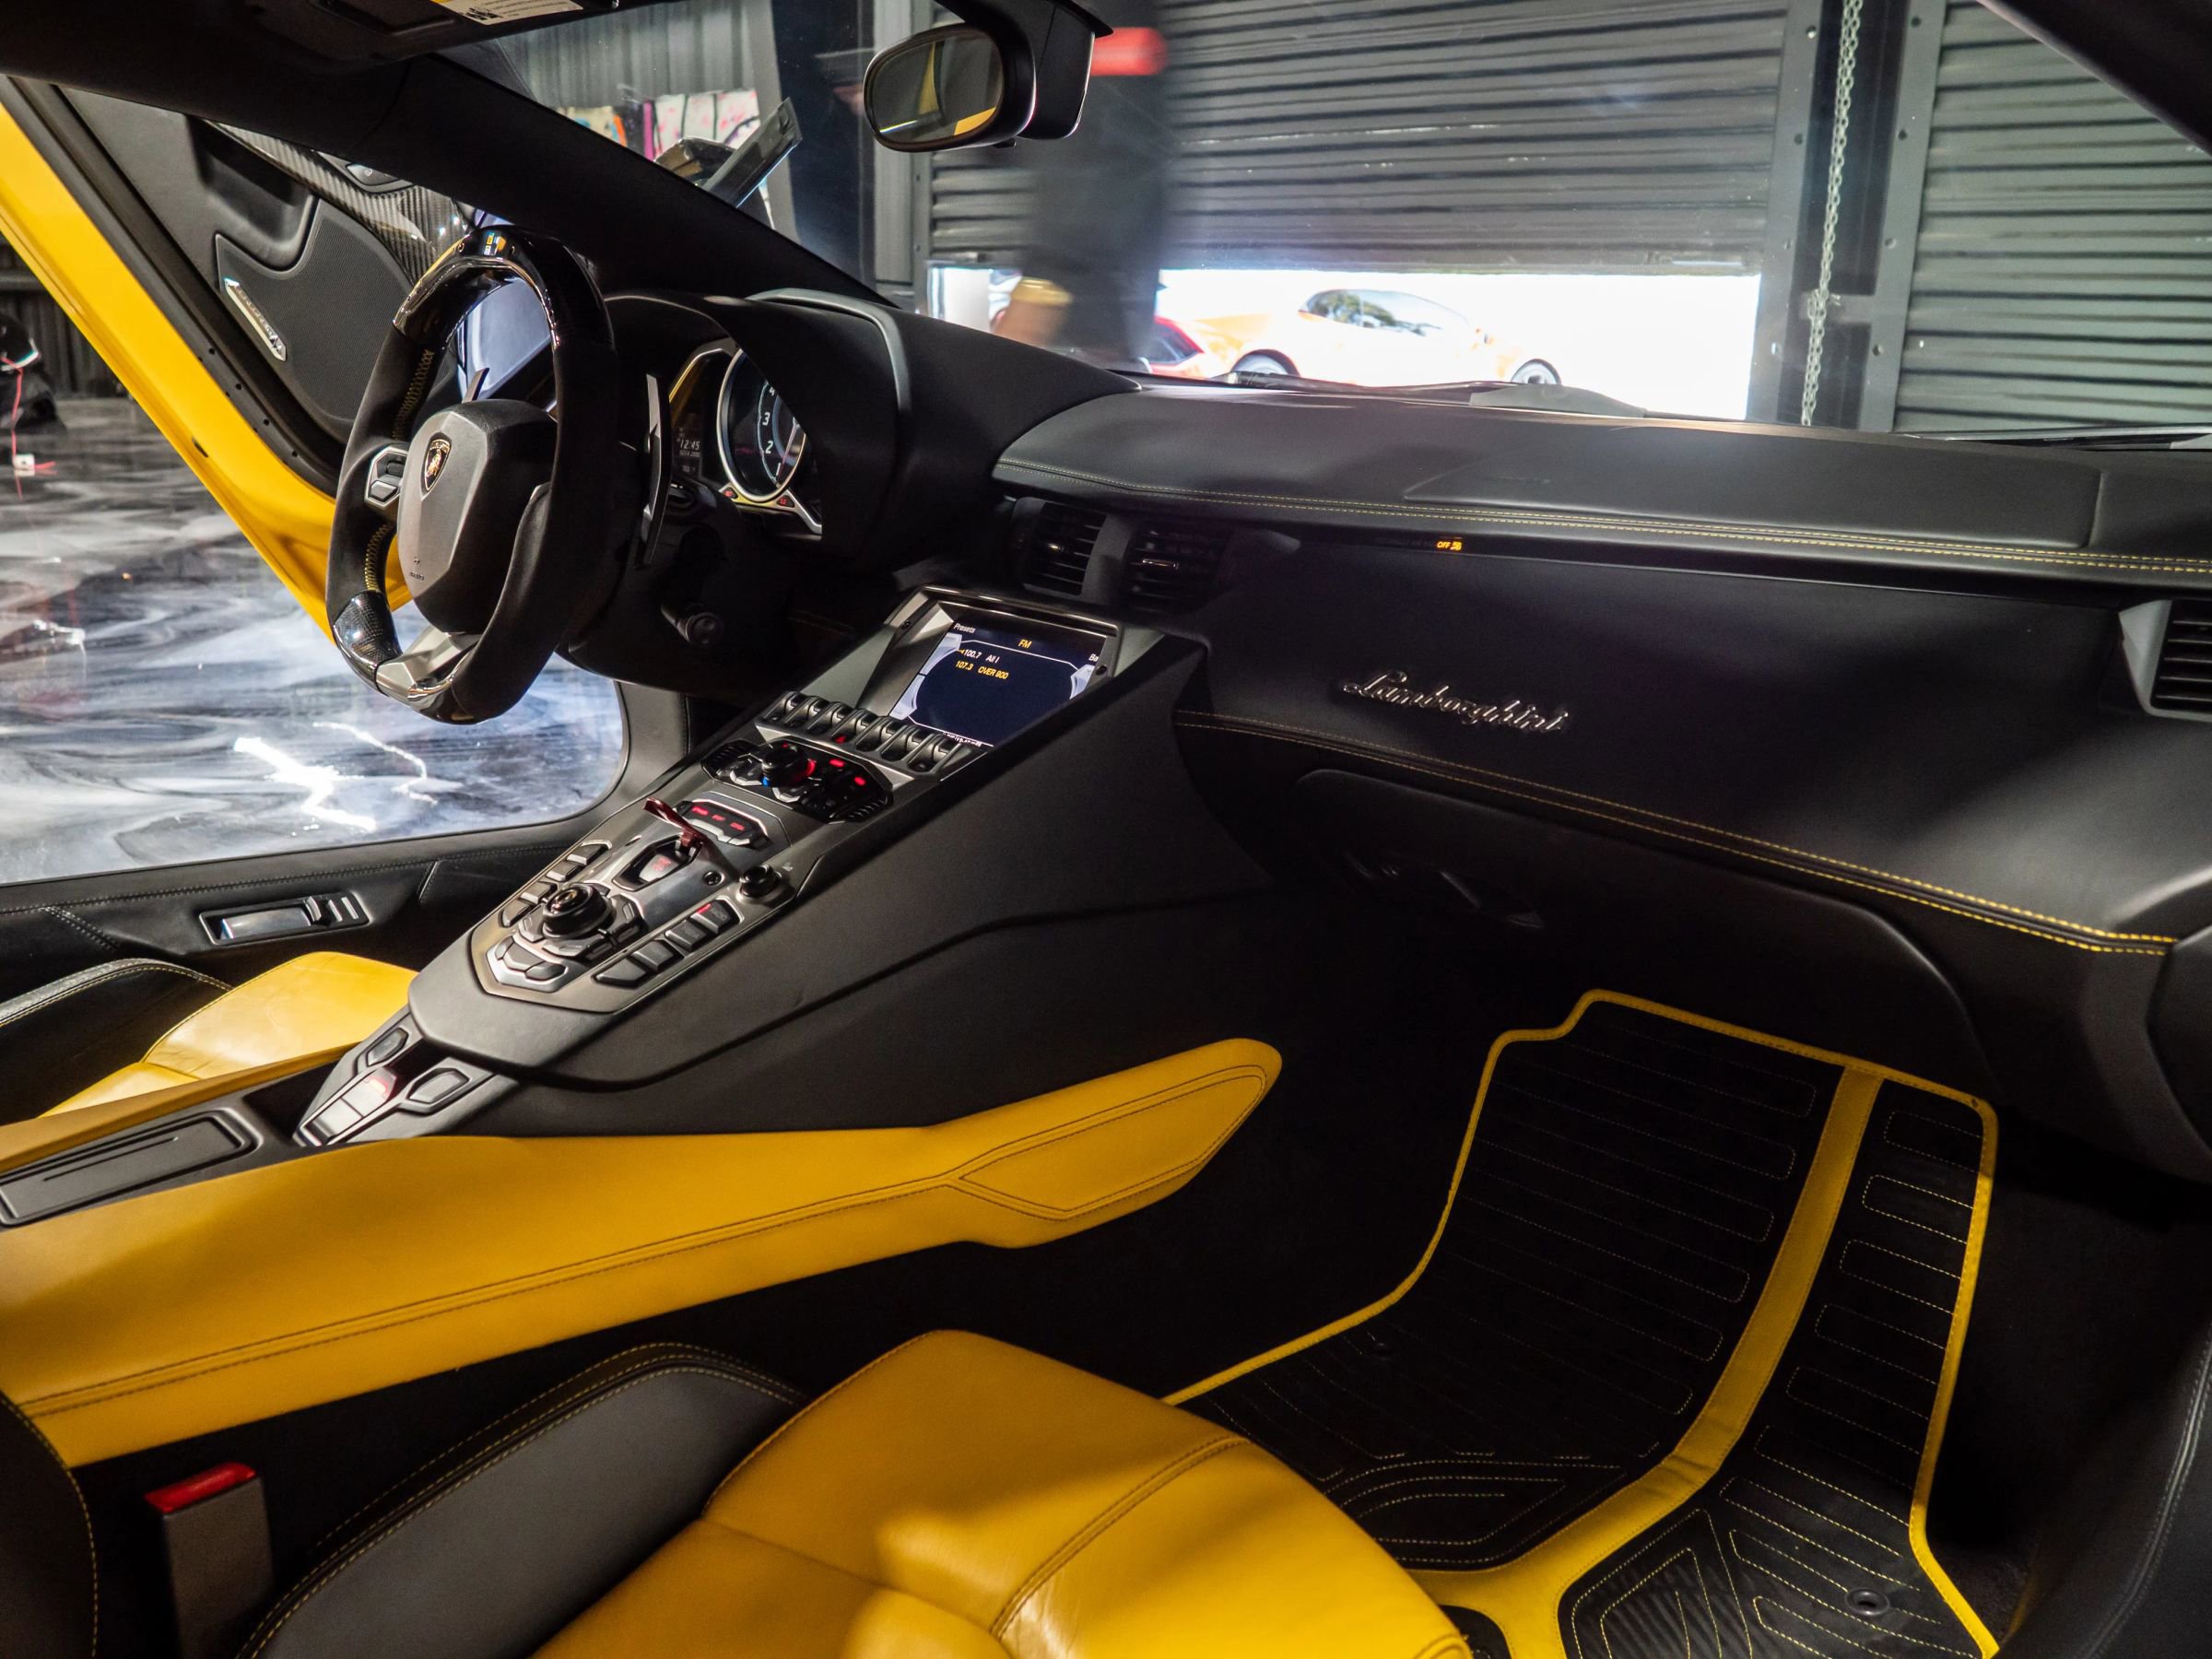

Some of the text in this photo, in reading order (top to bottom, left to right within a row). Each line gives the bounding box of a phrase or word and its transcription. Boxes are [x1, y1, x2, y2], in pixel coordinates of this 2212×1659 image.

[762, 411, 771, 426] 3
[679, 438, 700, 451] 12:45
[765, 441, 773, 454] 2
[775, 463, 782, 476] 1
[954, 622, 975, 633] Presets
[1018, 639, 1032, 648] FM
[963, 649, 982, 659] 100.7
[956, 660, 973, 670] 107.3
[978, 665, 996, 677] OVER
[1343, 670, 1569, 733] Lamborghini
